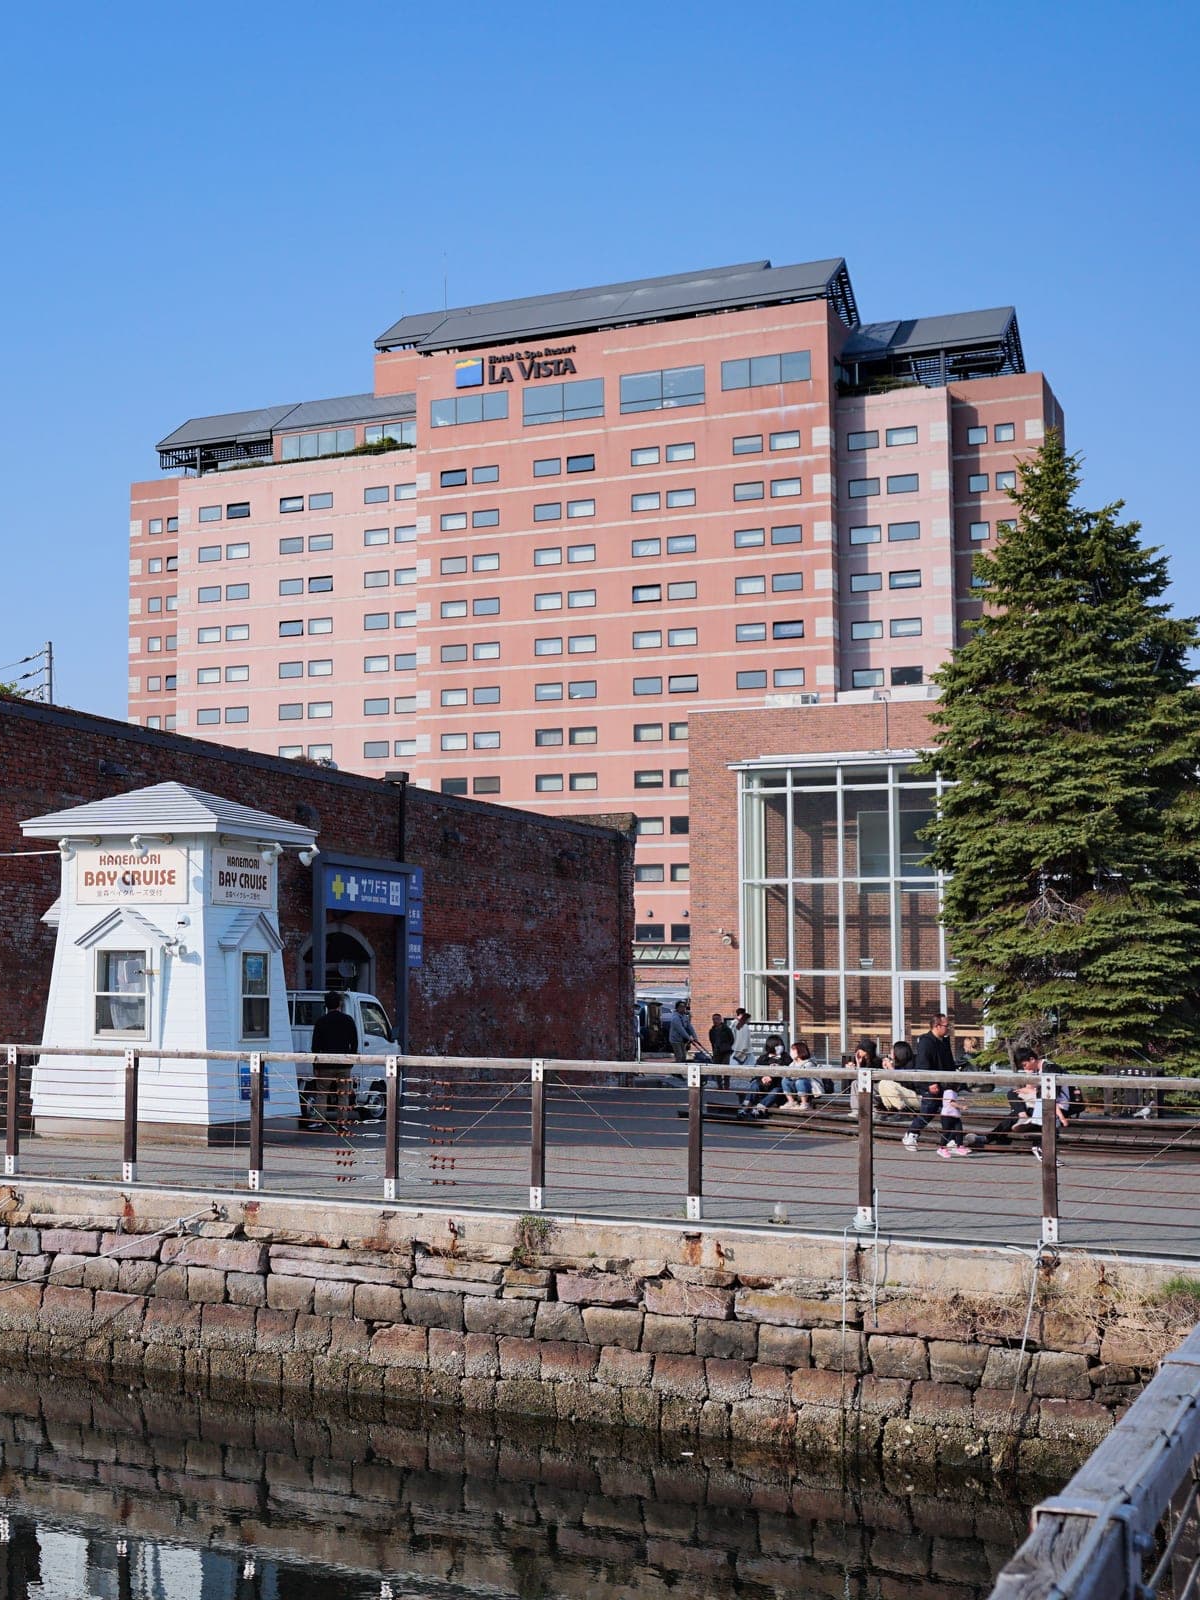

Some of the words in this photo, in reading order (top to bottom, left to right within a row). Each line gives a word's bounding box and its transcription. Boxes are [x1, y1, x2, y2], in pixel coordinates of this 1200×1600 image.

[488, 353, 514, 364] Hotel
[524, 350, 543, 361] Spa
[544, 345, 576, 356] Resort
[488, 364, 514, 385] LA
[517, 357, 577, 380] VISTA
[99, 853, 161, 866] KANEMORI
[226, 855, 260, 870] KANEMORI
[84, 870, 118, 887] BAY
[121, 869, 176, 886] CRUISE
[218, 870, 237, 888] BAY
[239, 872, 268, 891] CRUISE
